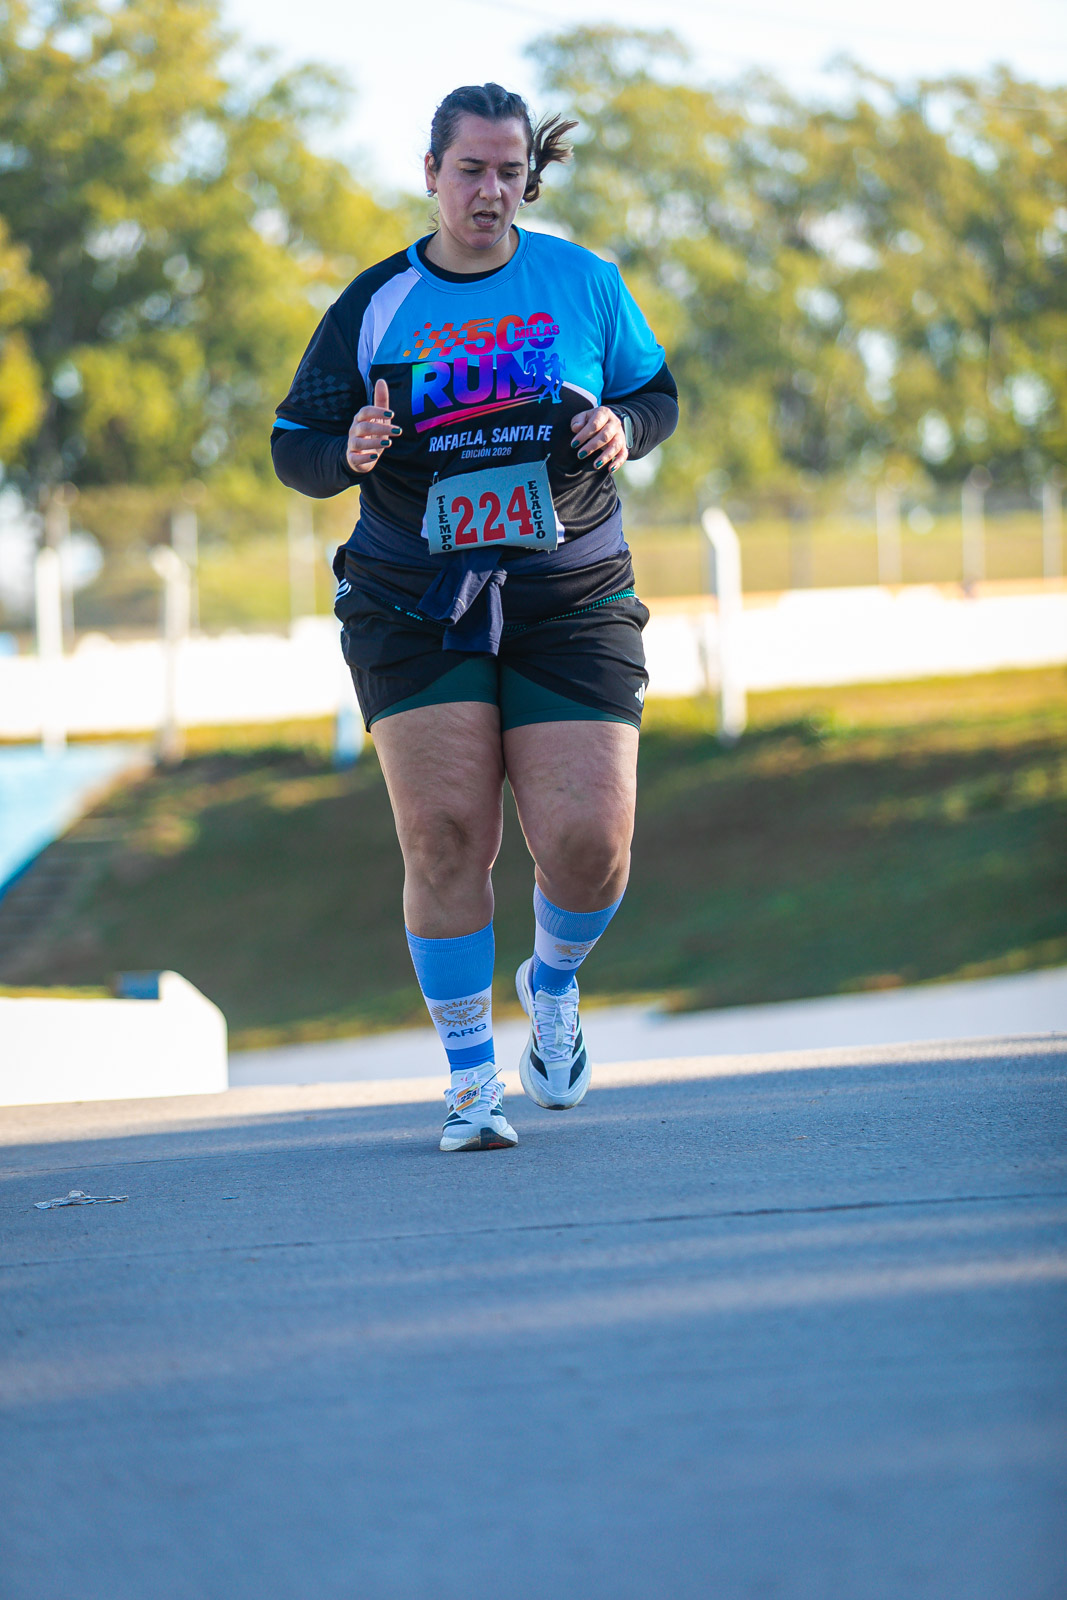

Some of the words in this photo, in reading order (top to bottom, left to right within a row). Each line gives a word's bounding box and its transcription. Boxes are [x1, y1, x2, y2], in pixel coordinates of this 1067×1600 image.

[464, 312, 555, 356] 500
[514, 325, 560, 340] MILLAS
[411, 351, 546, 415] RUN
[429, 429, 487, 452] RAFAELA,
[491, 425, 534, 443] SANTA
[536, 425, 553, 441] FE
[461, 447, 491, 459] EDICIÓN
[492, 447, 512, 457] 2026
[436, 495, 452, 551] TIEMPO
[451, 485, 535, 545] 224
[527, 480, 546, 539] EXACTO
[447, 1023, 487, 1038] ARG
